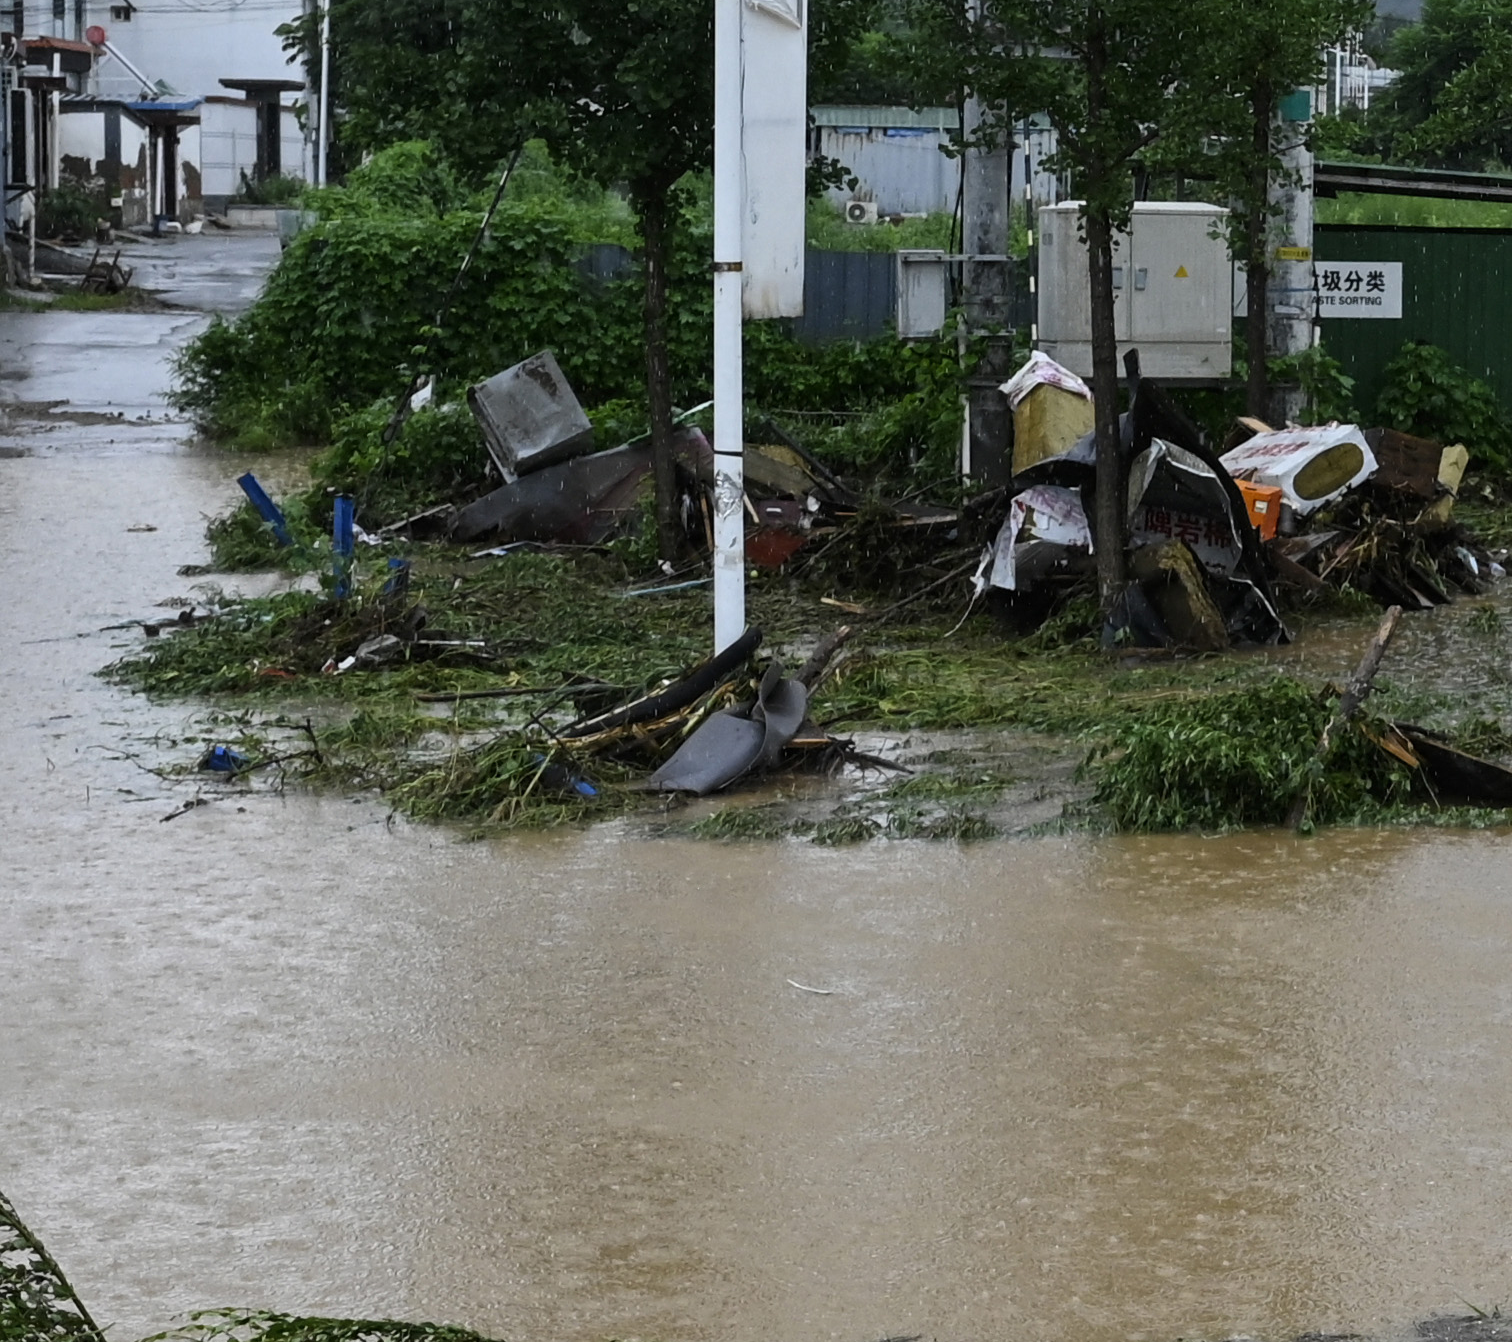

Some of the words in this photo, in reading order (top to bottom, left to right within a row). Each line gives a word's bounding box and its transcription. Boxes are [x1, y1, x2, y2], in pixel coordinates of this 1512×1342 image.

[1312, 296, 1336, 306] ASTE
[1338, 296, 1382, 306] SORTING
[1133, 507, 1233, 549] 隅岩棉
